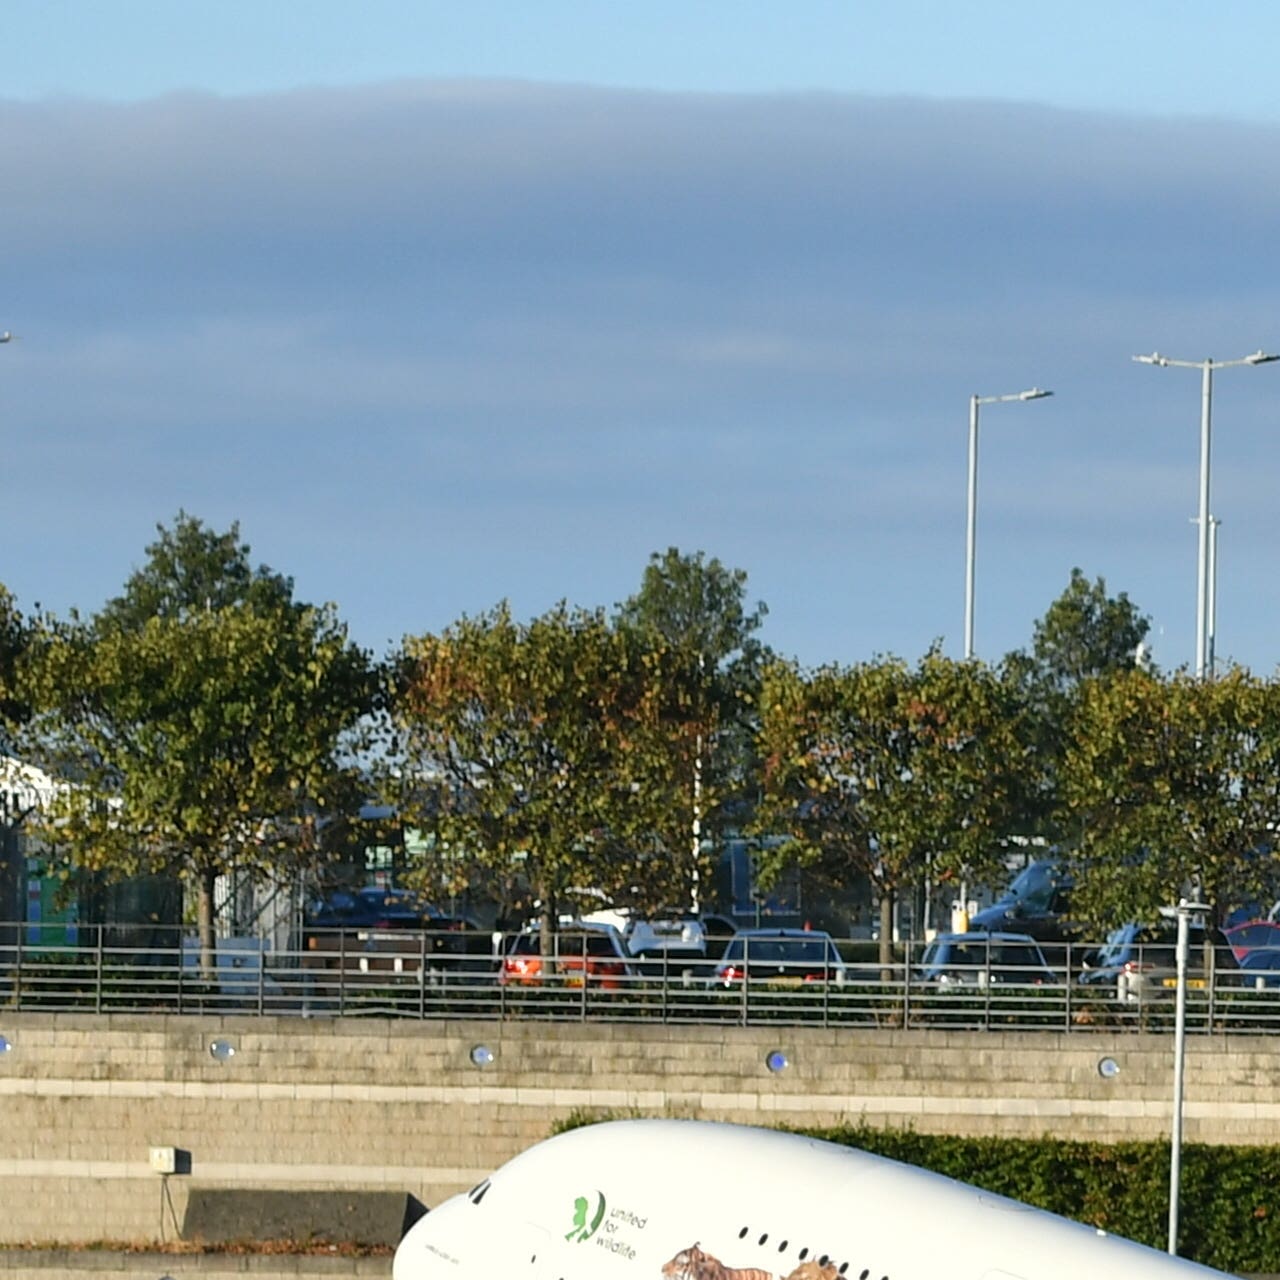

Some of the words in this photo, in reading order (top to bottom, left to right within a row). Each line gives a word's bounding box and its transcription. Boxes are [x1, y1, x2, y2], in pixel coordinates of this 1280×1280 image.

[603, 1220, 619, 1234] for
[610, 1208, 648, 1229] united
[597, 1236, 637, 1260] wildlife
